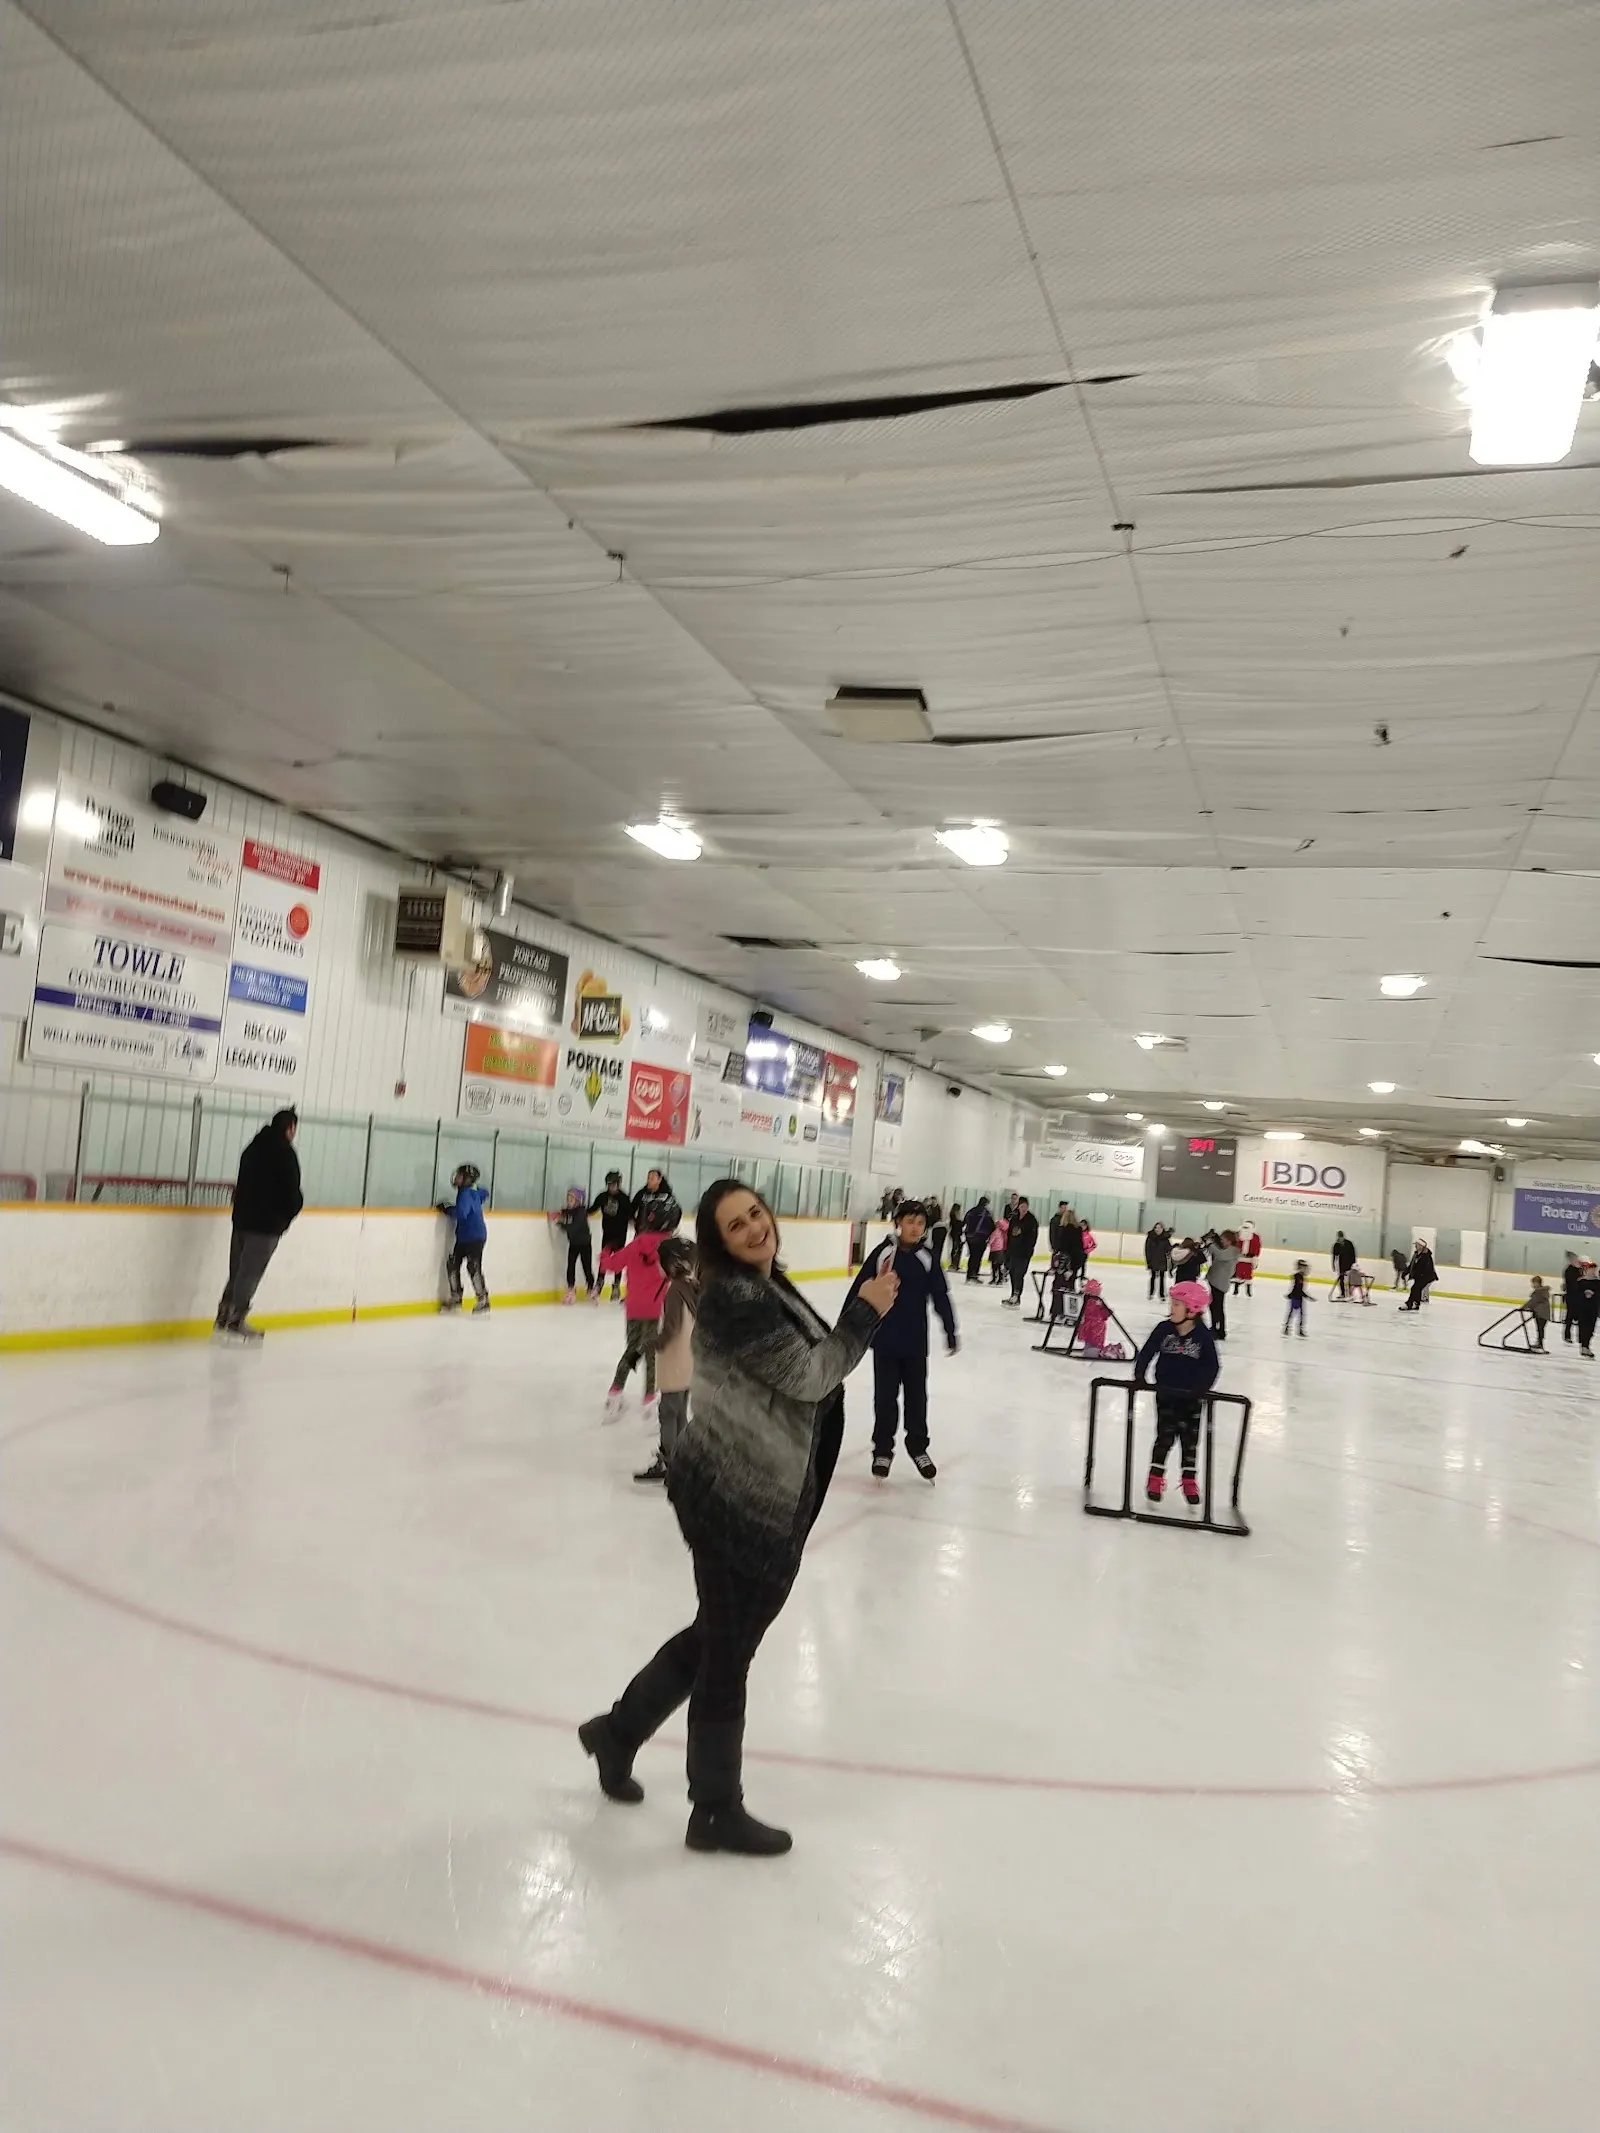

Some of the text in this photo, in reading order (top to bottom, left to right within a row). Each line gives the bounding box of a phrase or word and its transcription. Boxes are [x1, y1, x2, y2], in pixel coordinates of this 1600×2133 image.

[93, 934, 186, 985] TOWLE
[512, 944, 552, 973] PORTAGE
[68, 966, 171, 1004] CONSTRUCTION
[498, 961, 558, 996] PROFESSIONAL
[580, 1002, 621, 1034] McCain
[266, 1023, 288, 1046] CUP
[225, 1046, 268, 1071] LEGACY
[268, 1052, 297, 1076] FUND
[566, 1048, 625, 1080] PORTAGE
[1273, 1161, 1346, 1190] BDO
[1243, 1194, 1364, 1214] Centre for the Community
[1524, 1193, 1555, 1205] Portage
[1541, 1204, 1590, 1223] Rotary
[1567, 1222, 1589, 1232] Club
